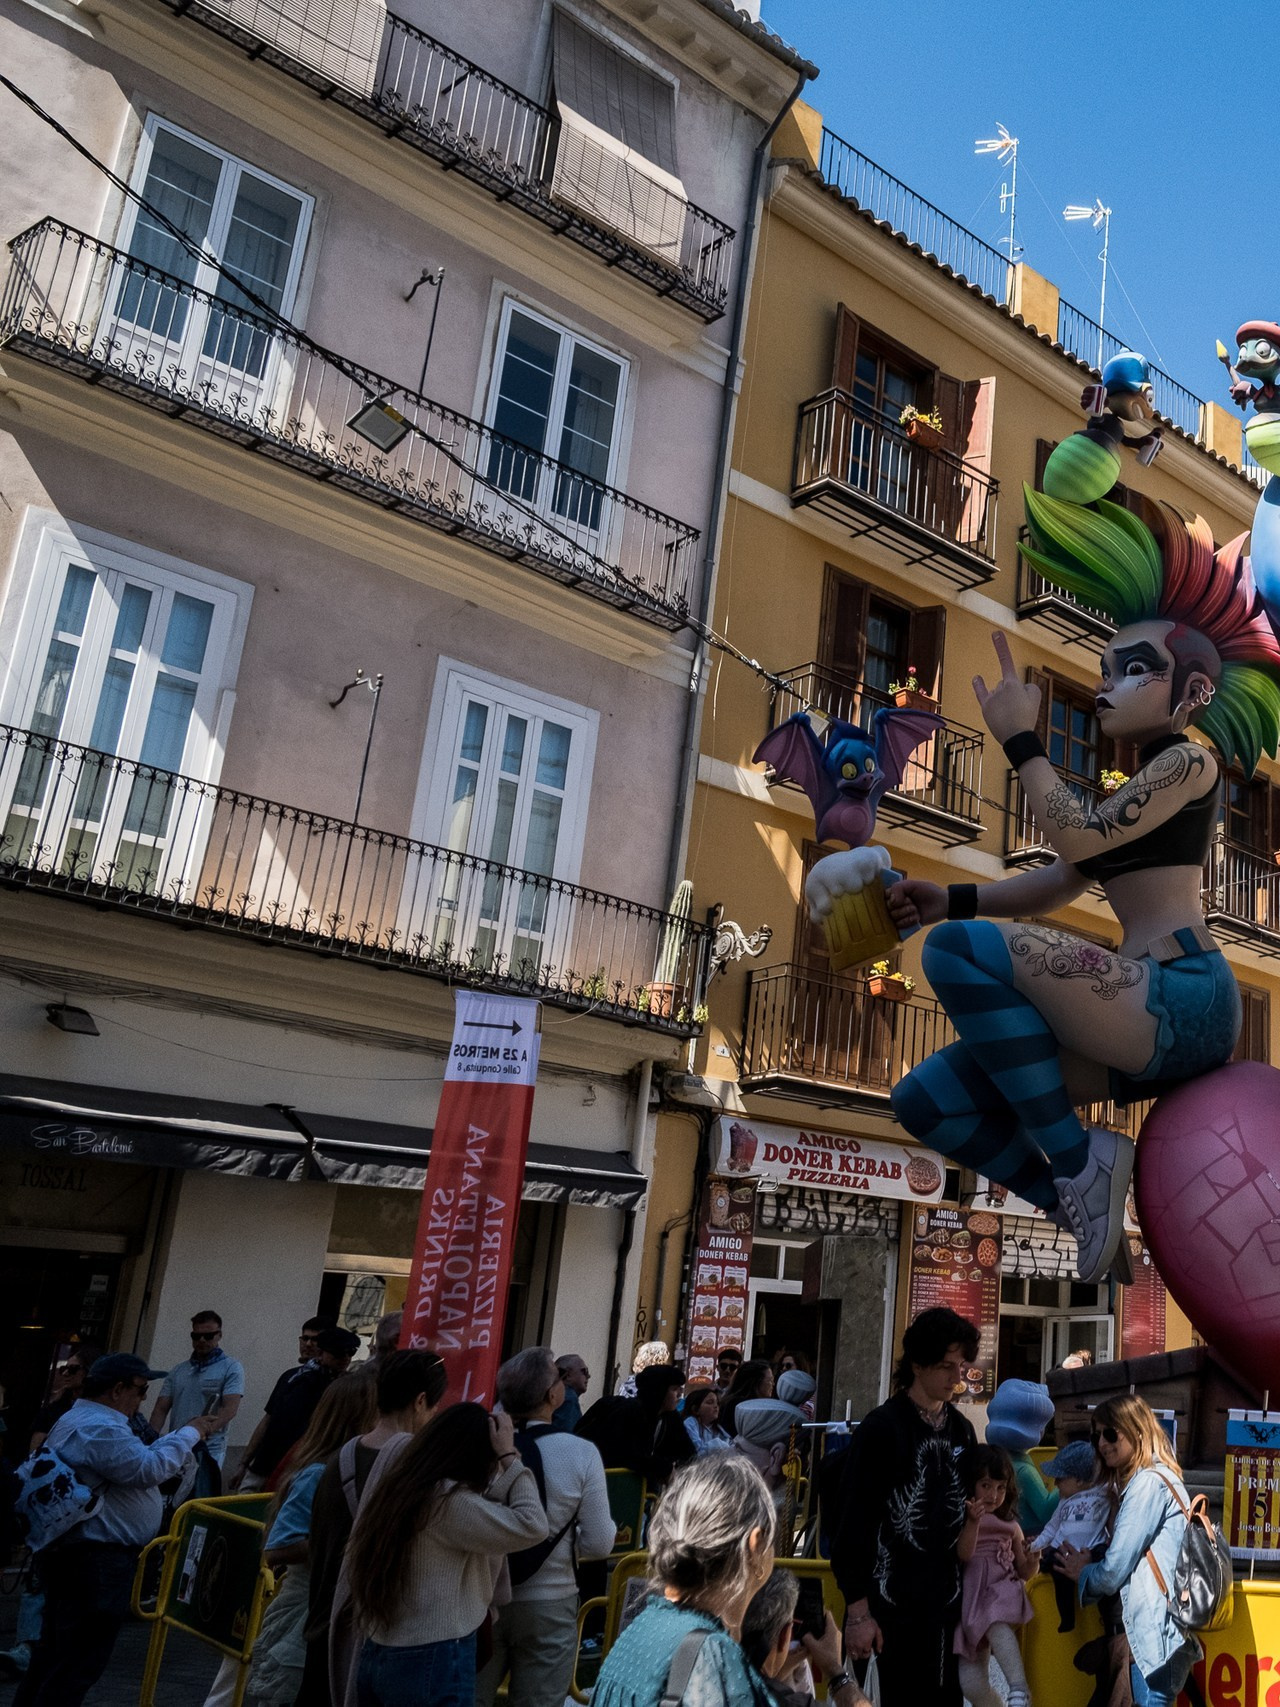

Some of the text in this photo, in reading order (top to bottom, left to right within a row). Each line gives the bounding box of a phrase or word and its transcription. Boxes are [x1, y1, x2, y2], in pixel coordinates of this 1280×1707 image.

[31, 1124, 135, 1155] San Bartolomé
[797, 1131, 861, 1154] AMIGO
[762, 1143, 902, 1180] DONER KEBAB
[786, 1168, 870, 1190] PIZZERIA
[936, 1209, 958, 1220] AMIGO
[929, 1219, 963, 1229] DONER KEBAB
[708, 1236, 742, 1250] AMIGO
[699, 1249, 749, 1262] DONER KEBAB
[1253, 1492, 1268, 1518] 5
[1237, 1521, 1280, 1534] Josep Bea
